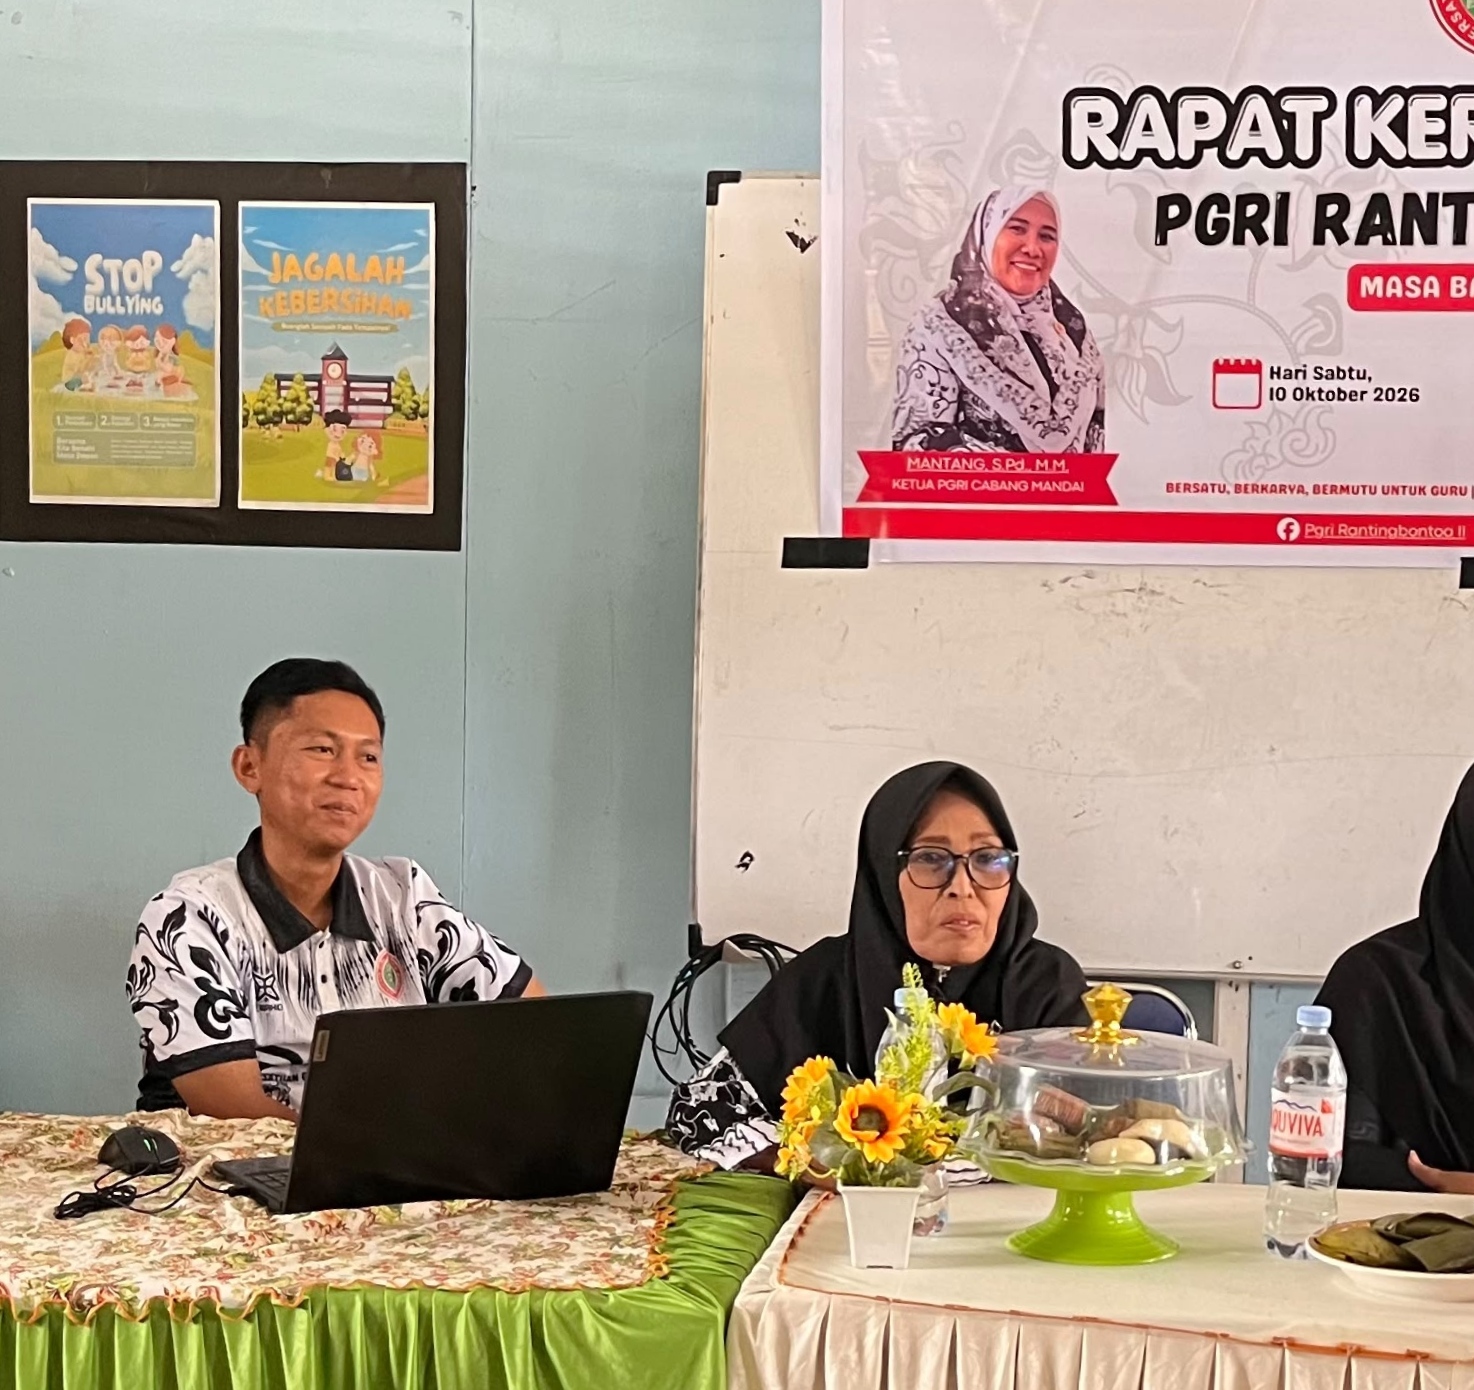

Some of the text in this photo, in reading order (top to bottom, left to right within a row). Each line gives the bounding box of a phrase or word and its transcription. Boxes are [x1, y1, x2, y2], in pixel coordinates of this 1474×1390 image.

[1063, 86, 1336, 169] RAPAT
[1154, 192, 1288, 247] PGRI
[85, 250, 163, 295] STOP
[268, 251, 405, 285] JAGALAH
[1359, 274, 1442, 300] MASA
[84, 294, 164, 315] BULLYING
[1269, 365, 1372, 383] Hari Sabtu,
[1293, 387, 1368, 402] Oktober
[1374, 388, 1420, 402] 2026
[907, 457, 989, 473] MANTANG,
[892, 478, 1084, 492] KETUA PGRI CABANG MANDAI
[1166, 482, 1468, 497] BERSATU, BERKARYA, BERMUTU UNTUK GURU
